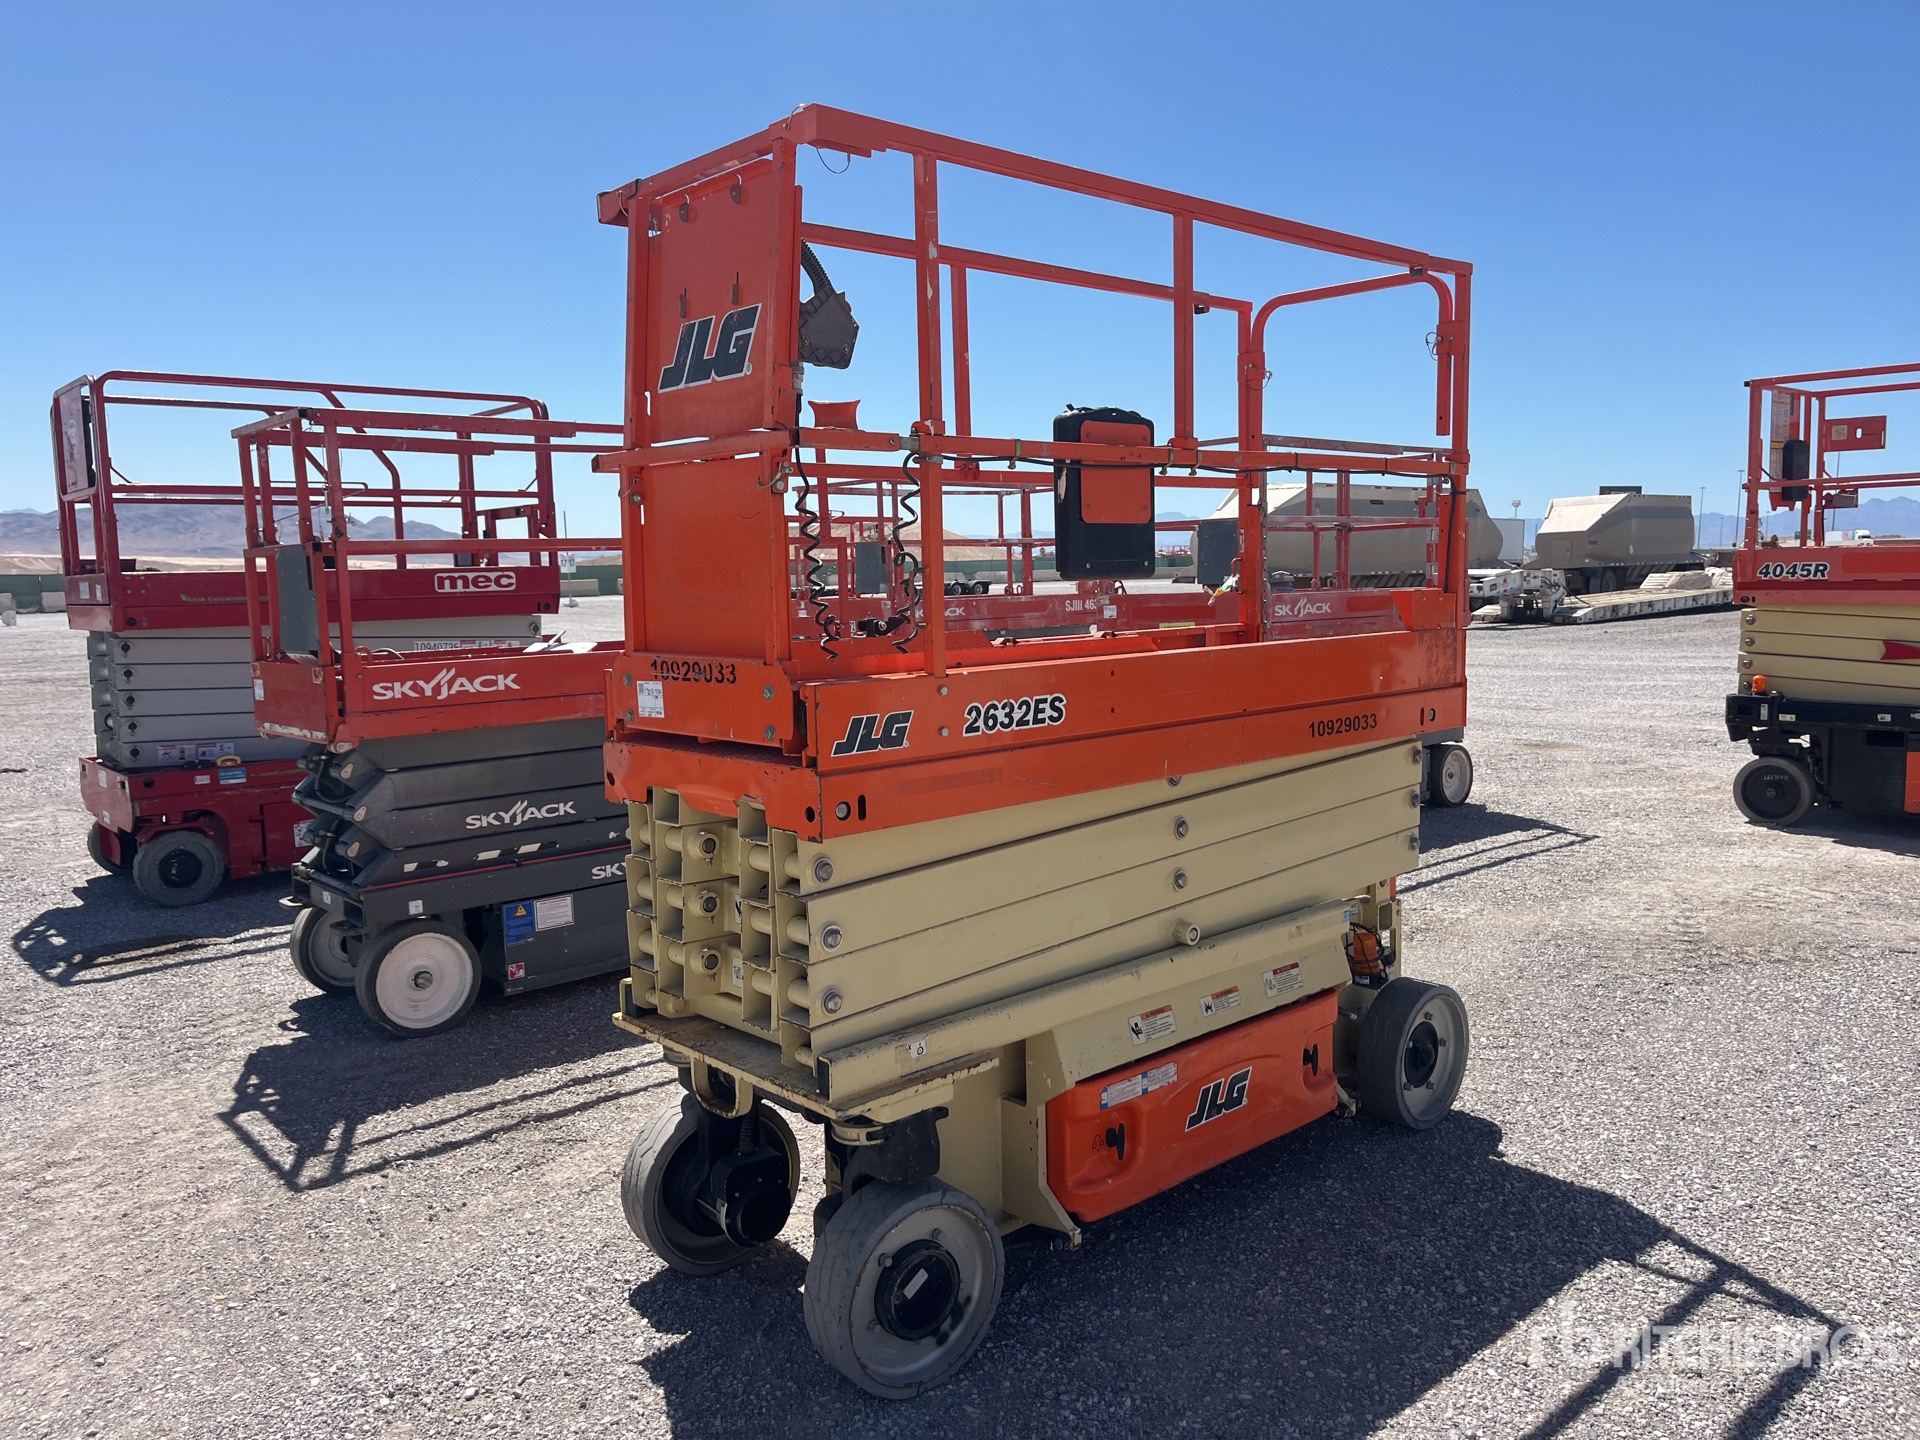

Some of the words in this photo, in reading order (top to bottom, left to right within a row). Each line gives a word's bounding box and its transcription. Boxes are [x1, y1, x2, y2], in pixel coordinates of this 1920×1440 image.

[658, 303, 762, 393] JLG
[436, 573, 515, 590] mec
[1757, 562, 1830, 579] 4045R
[371, 667, 522, 700] SKYJACK
[650, 659, 737, 685] 10929033
[831, 710, 914, 757] JLG
[963, 693, 1067, 737] 2632ES
[1309, 713, 1378, 738] 10929033
[465, 800, 577, 829] SKYJACK
[1185, 1066, 1252, 1132] JLG
